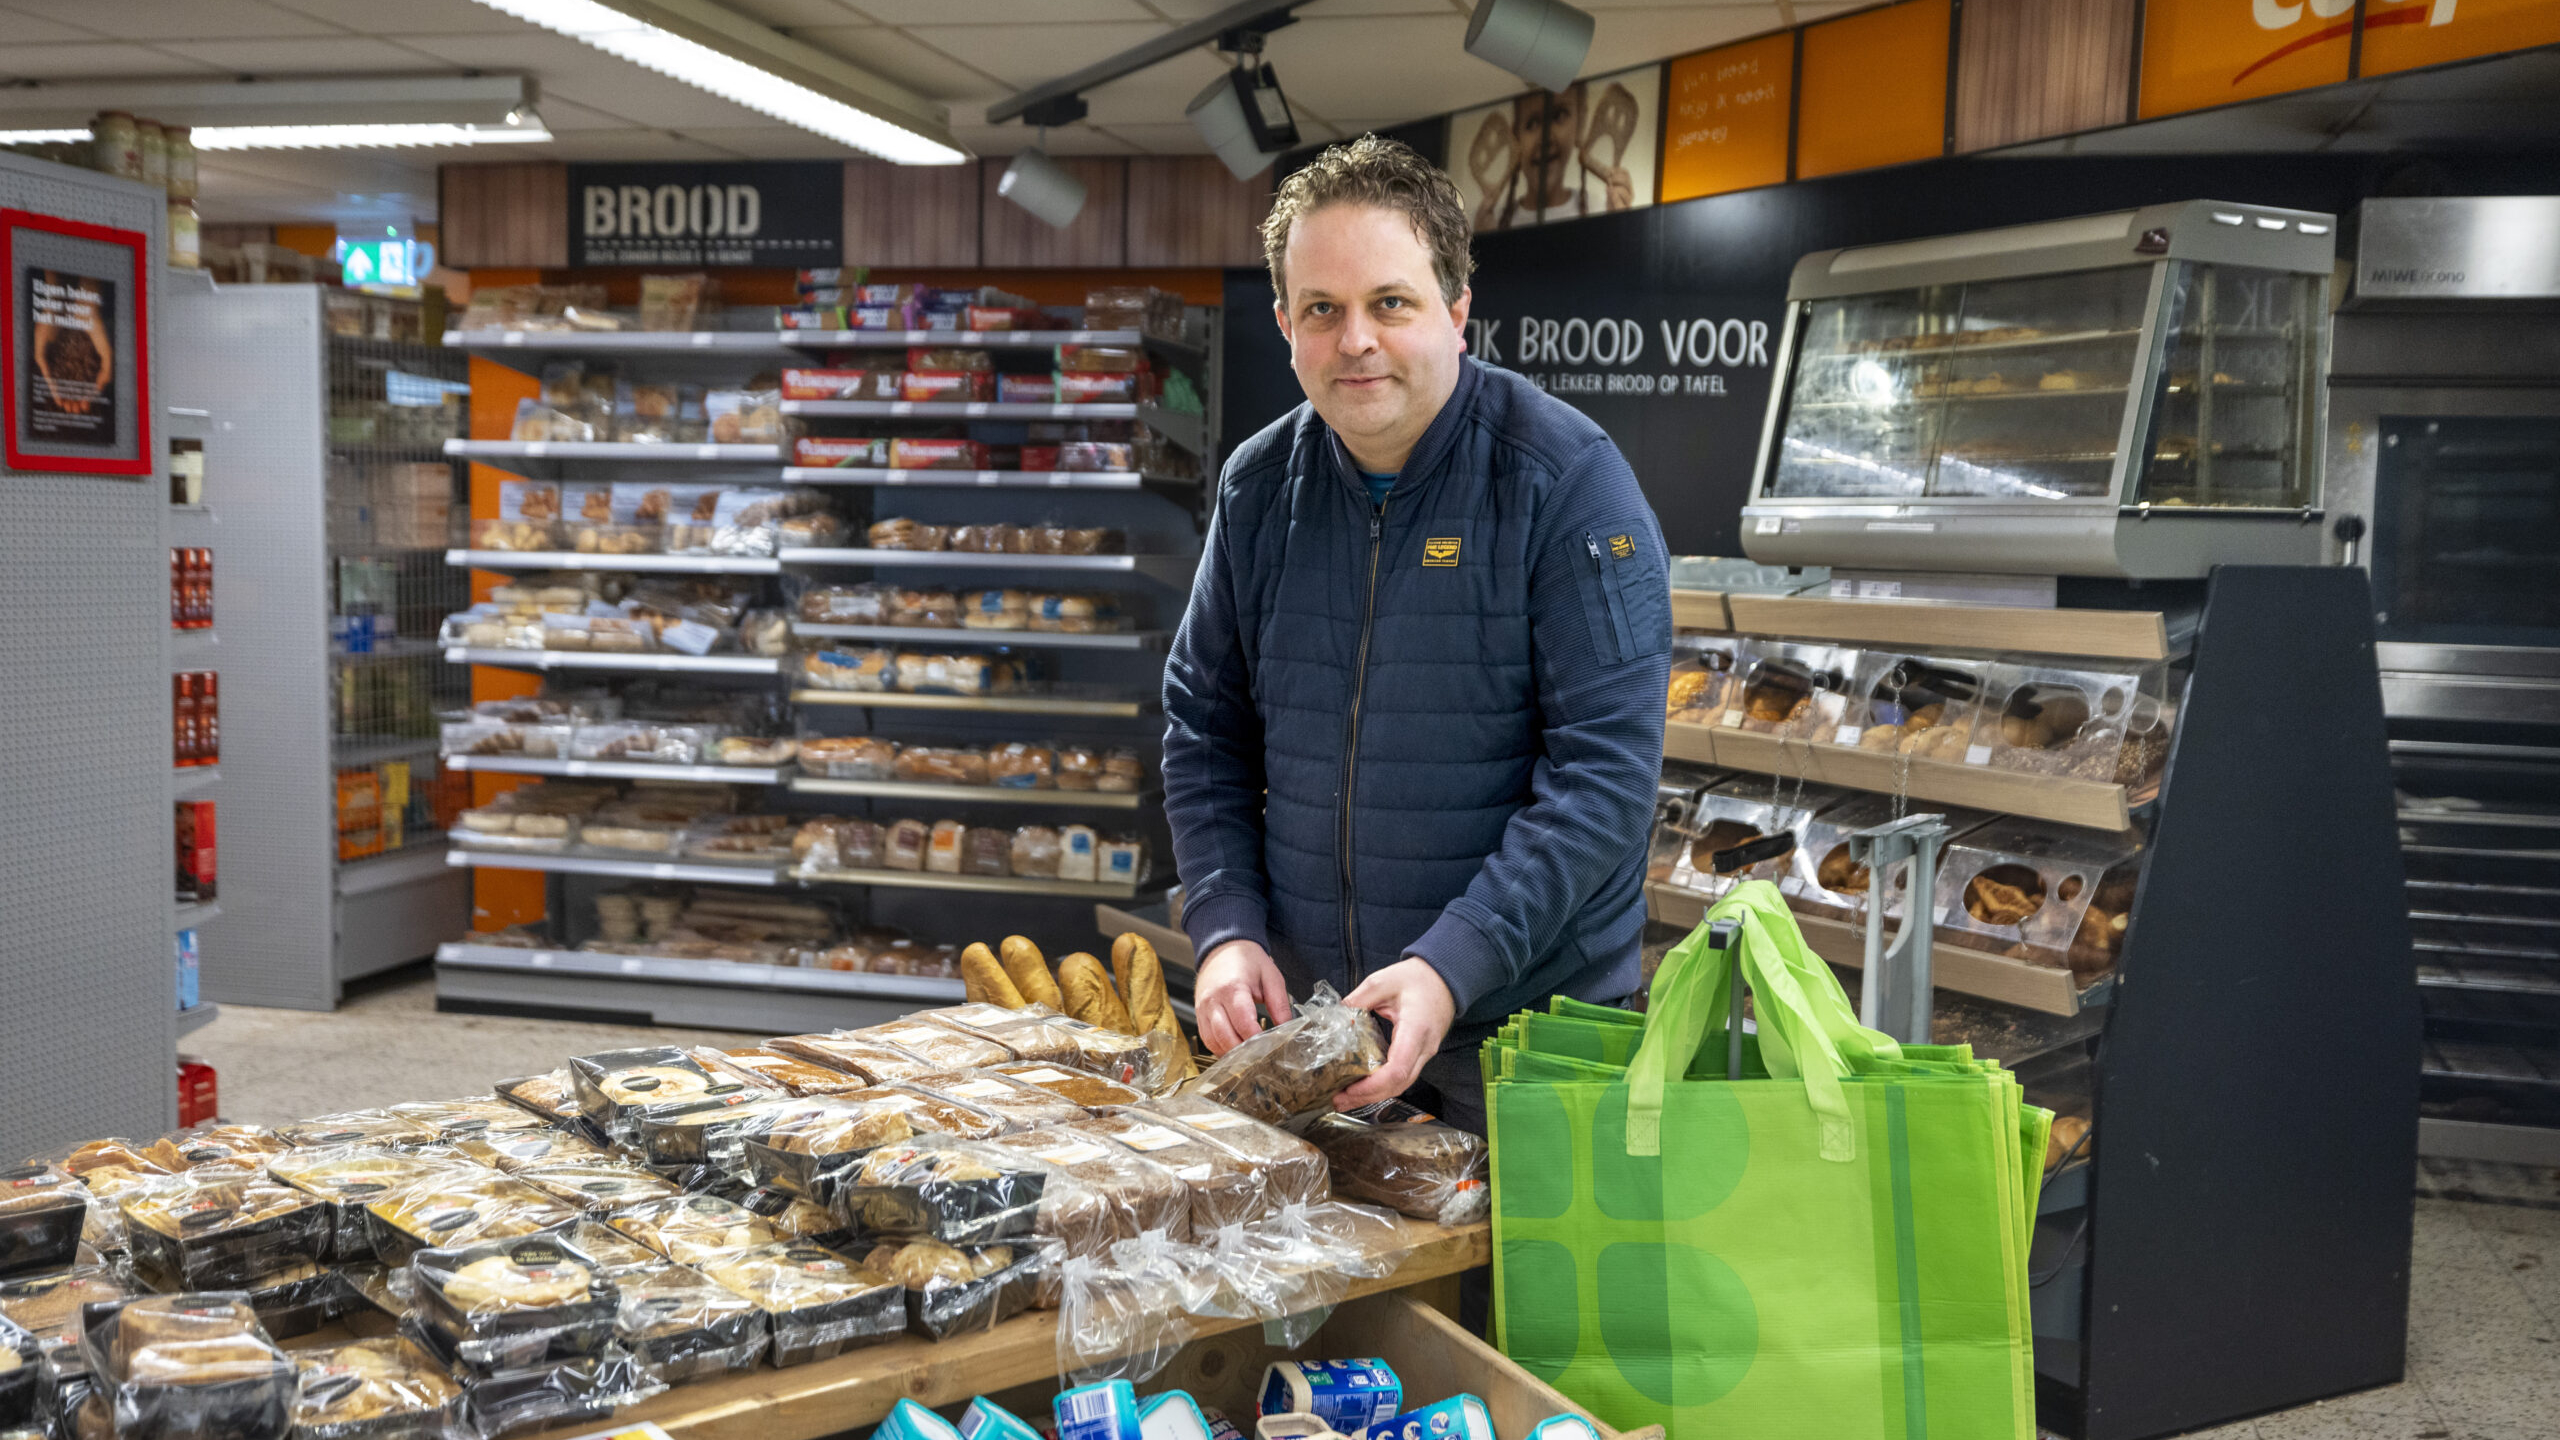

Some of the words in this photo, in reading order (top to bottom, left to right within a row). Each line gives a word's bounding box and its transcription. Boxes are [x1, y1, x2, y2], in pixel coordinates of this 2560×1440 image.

[584, 184, 761, 237] BROOD
[1466, 318, 1502, 361] JK
[1519, 316, 1643, 364] BROOD
[1660, 317, 1769, 366] VOOR
[1525, 372, 1547, 391] AG
[1551, 373, 1604, 393] LEKKER
[1607, 374, 1655, 394] BROOD
[1659, 374, 1680, 395] OP
[1684, 374, 1728, 395] TAFEL
